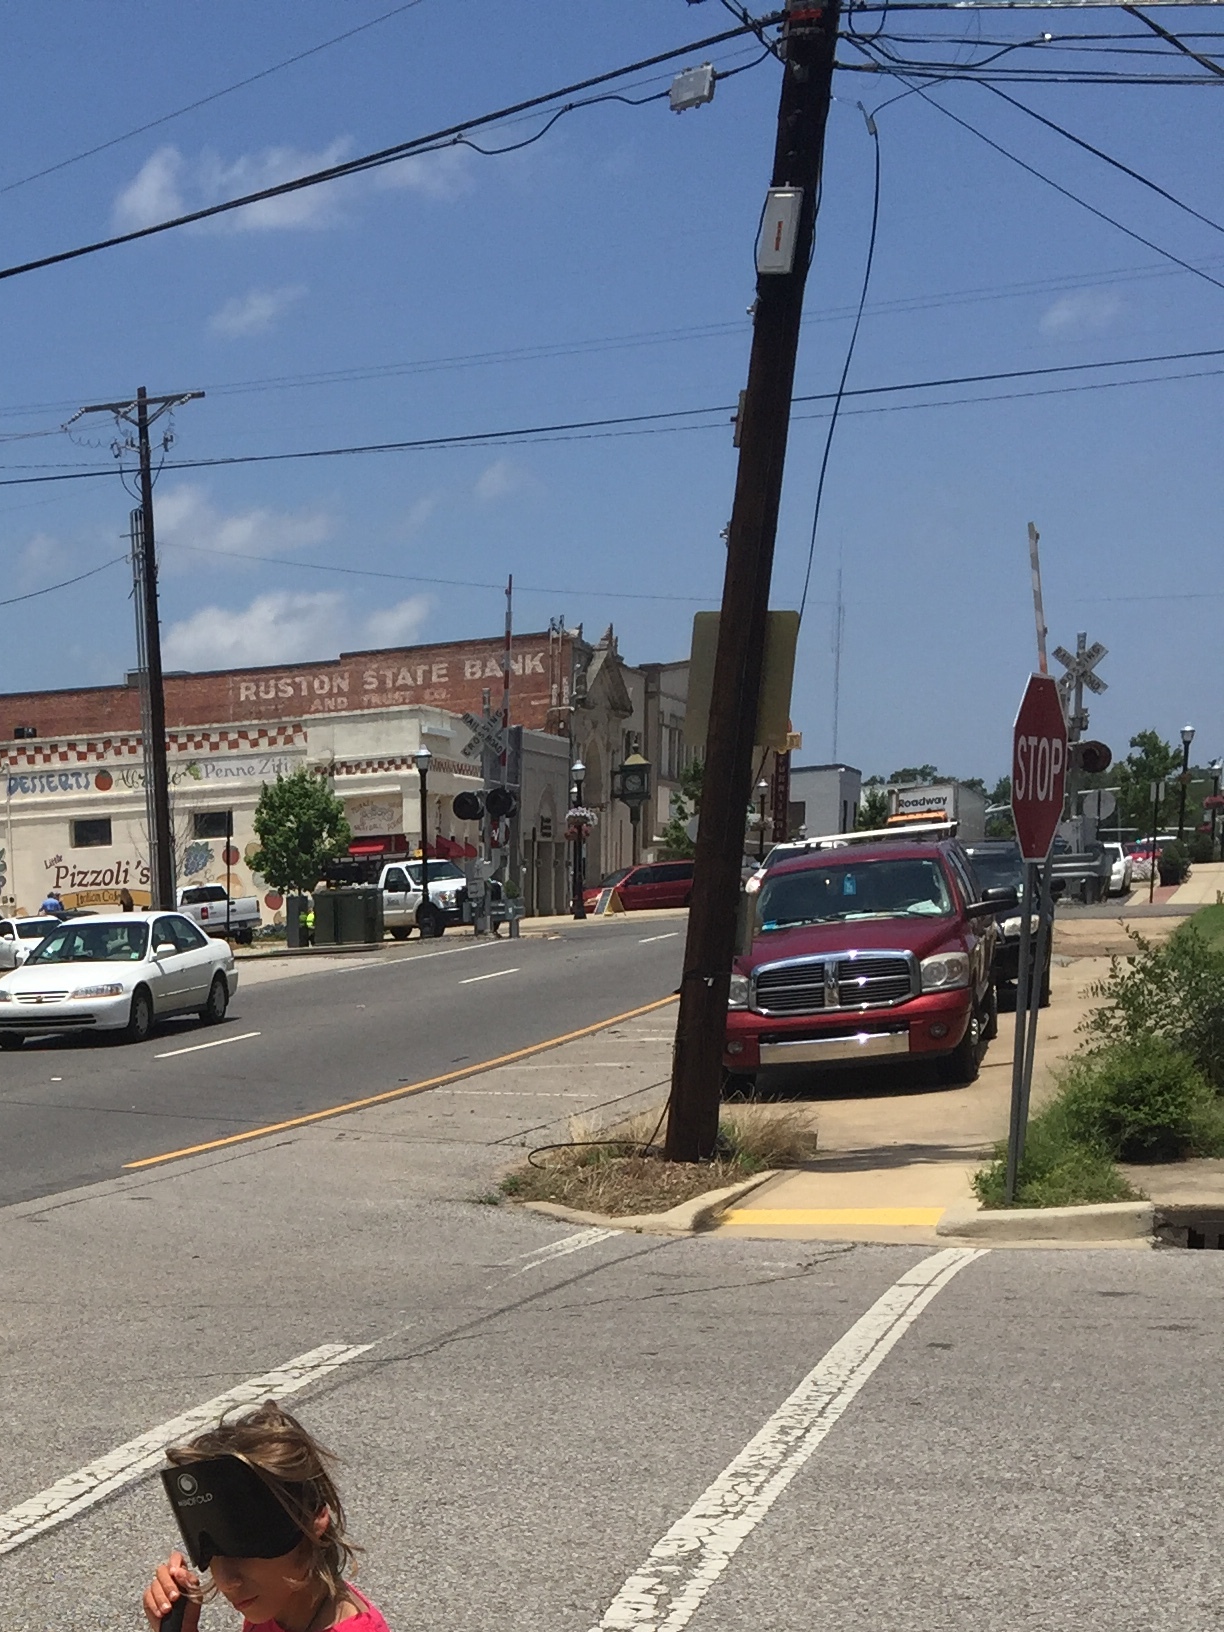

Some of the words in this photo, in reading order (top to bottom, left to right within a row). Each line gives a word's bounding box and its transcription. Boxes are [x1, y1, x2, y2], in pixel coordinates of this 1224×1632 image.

[239, 671, 350, 702] RUSTON
[362, 661, 450, 691] STATE
[463, 652, 546, 681] BANK
[310, 696, 348, 713] AND
[463, 709, 503, 756] CROSSING
[203, 762, 256, 779] Penne
[1015, 734, 1063, 802] STOP
[7, 771, 91, 796] DESSERTS
[898, 795, 948, 809] Roadway
[52, 859, 151, 889] Pizzoli's
